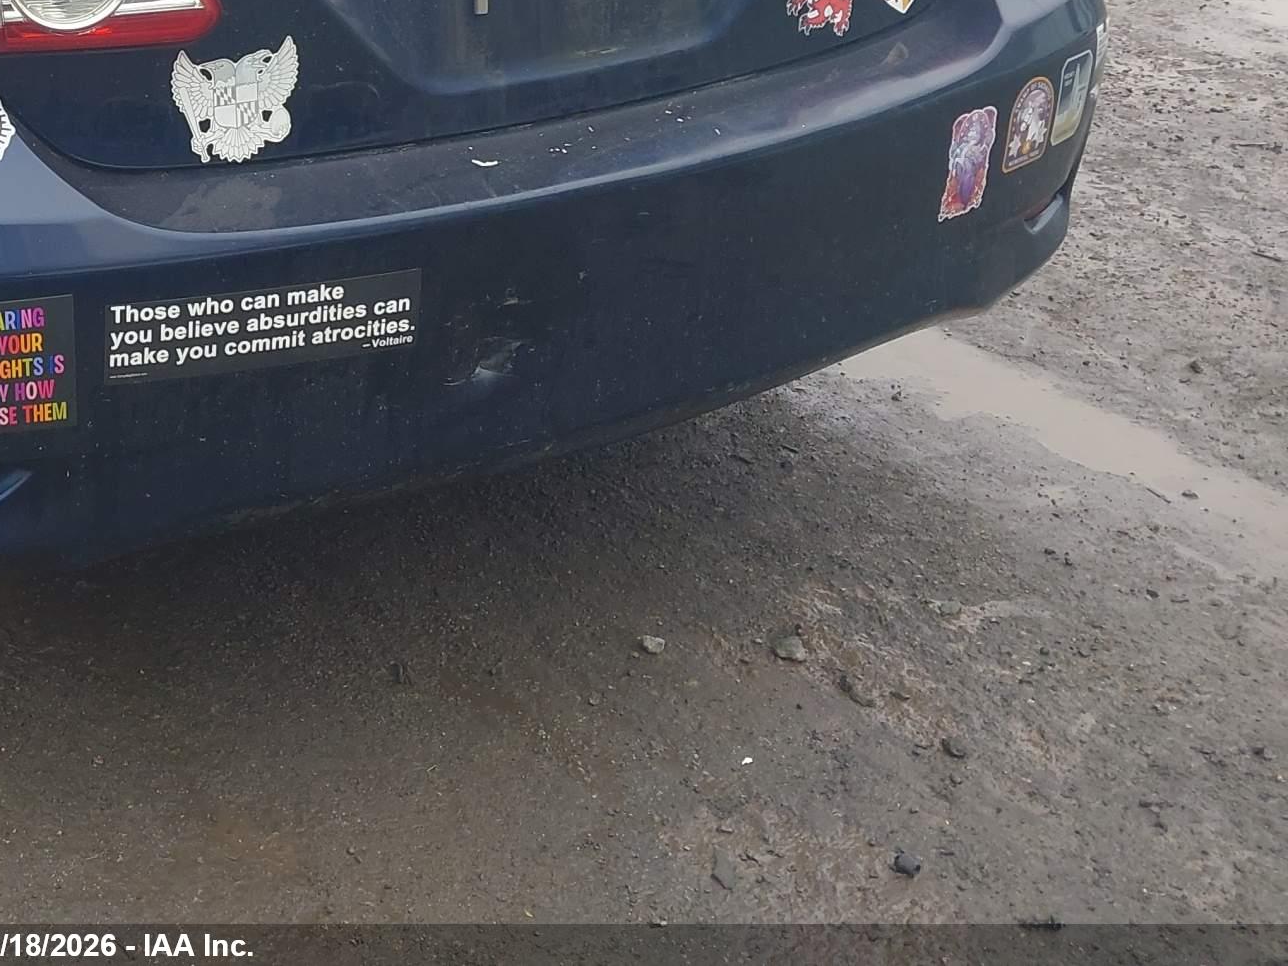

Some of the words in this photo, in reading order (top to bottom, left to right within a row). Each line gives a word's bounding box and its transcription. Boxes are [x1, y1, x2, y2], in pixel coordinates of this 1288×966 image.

[110, 304, 181, 324] Those
[187, 297, 234, 317] who
[241, 293, 280, 311] can
[287, 284, 345, 306] make
[110, 329, 152, 350] you
[160, 320, 240, 342] believe
[246, 303, 367, 332] absurdities
[373, 297, 410, 316] can
[109, 347, 169, 368] make
[176, 343, 217, 366] you
[224, 330, 306, 356] commit
[312, 318, 416, 345] atrocities.
[49, 354, 65, 375] IS
[14, 379, 55, 401] HOW
[22, 401, 67, 423] THEM
